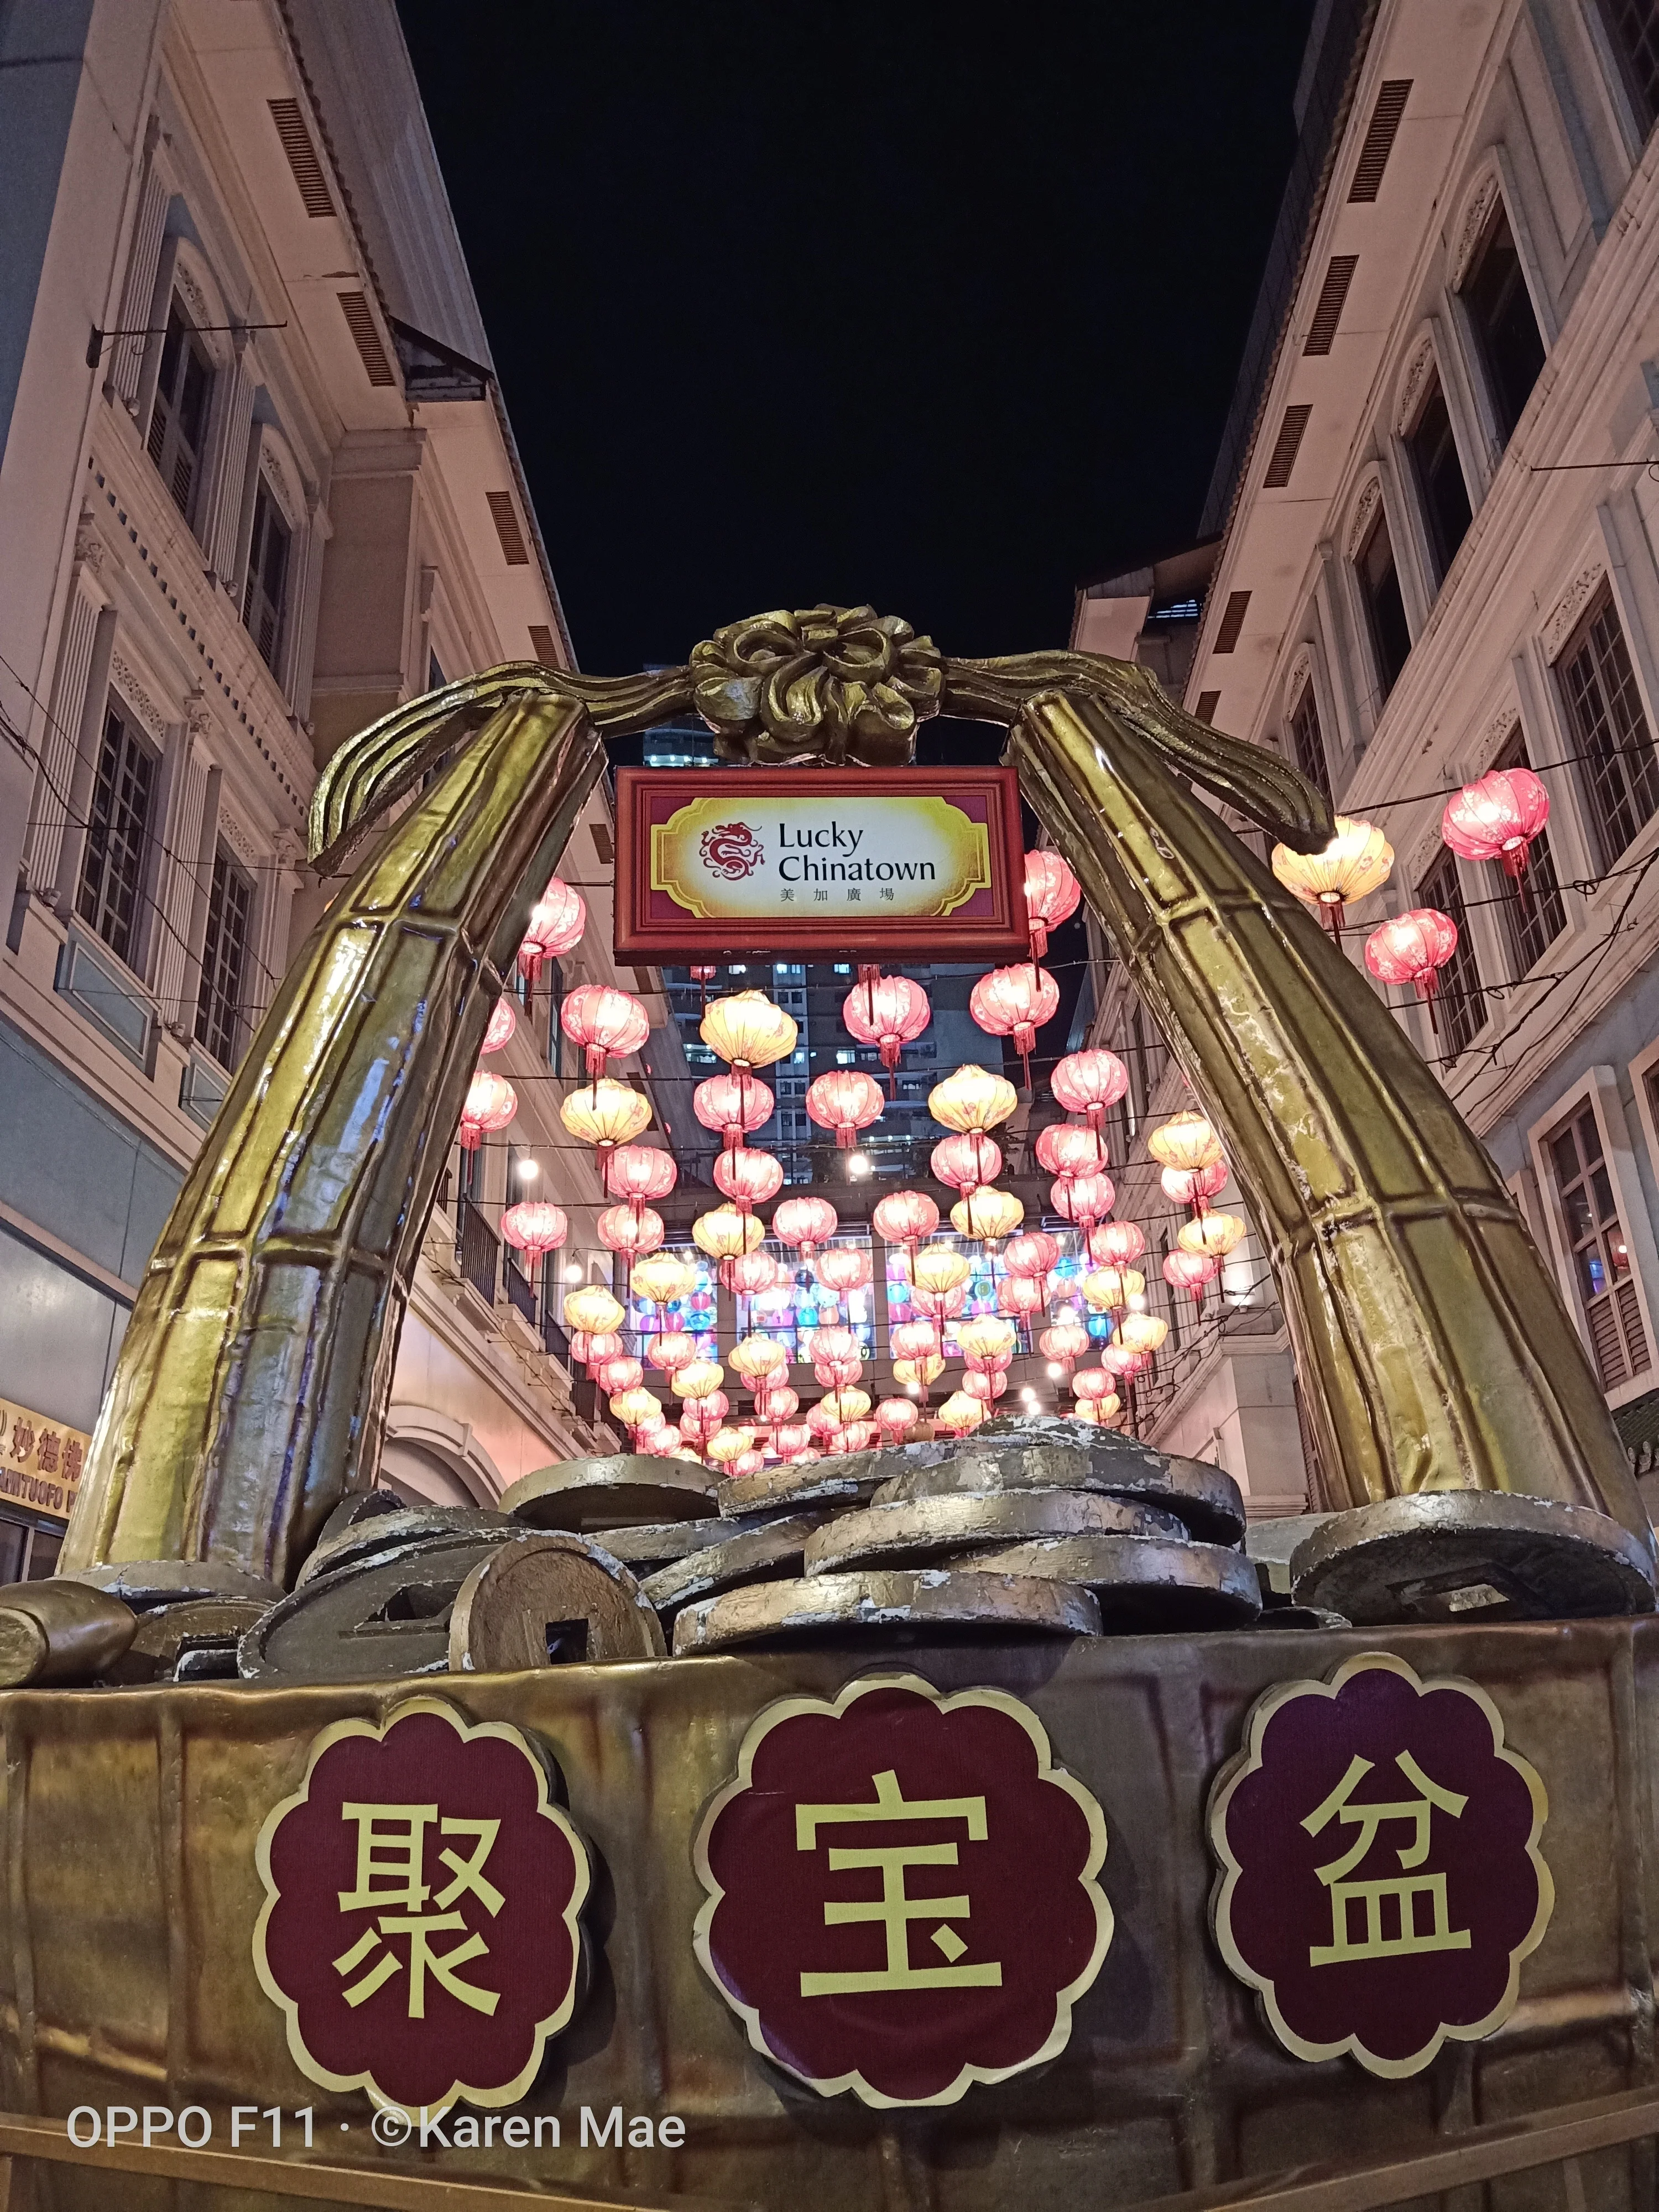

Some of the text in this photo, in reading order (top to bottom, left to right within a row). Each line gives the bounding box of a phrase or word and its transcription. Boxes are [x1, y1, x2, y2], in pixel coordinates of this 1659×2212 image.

[779, 821, 864, 857] Lucky
[778, 854, 936, 882] Chinatown
[779, 887, 895, 902] 美加廣場
